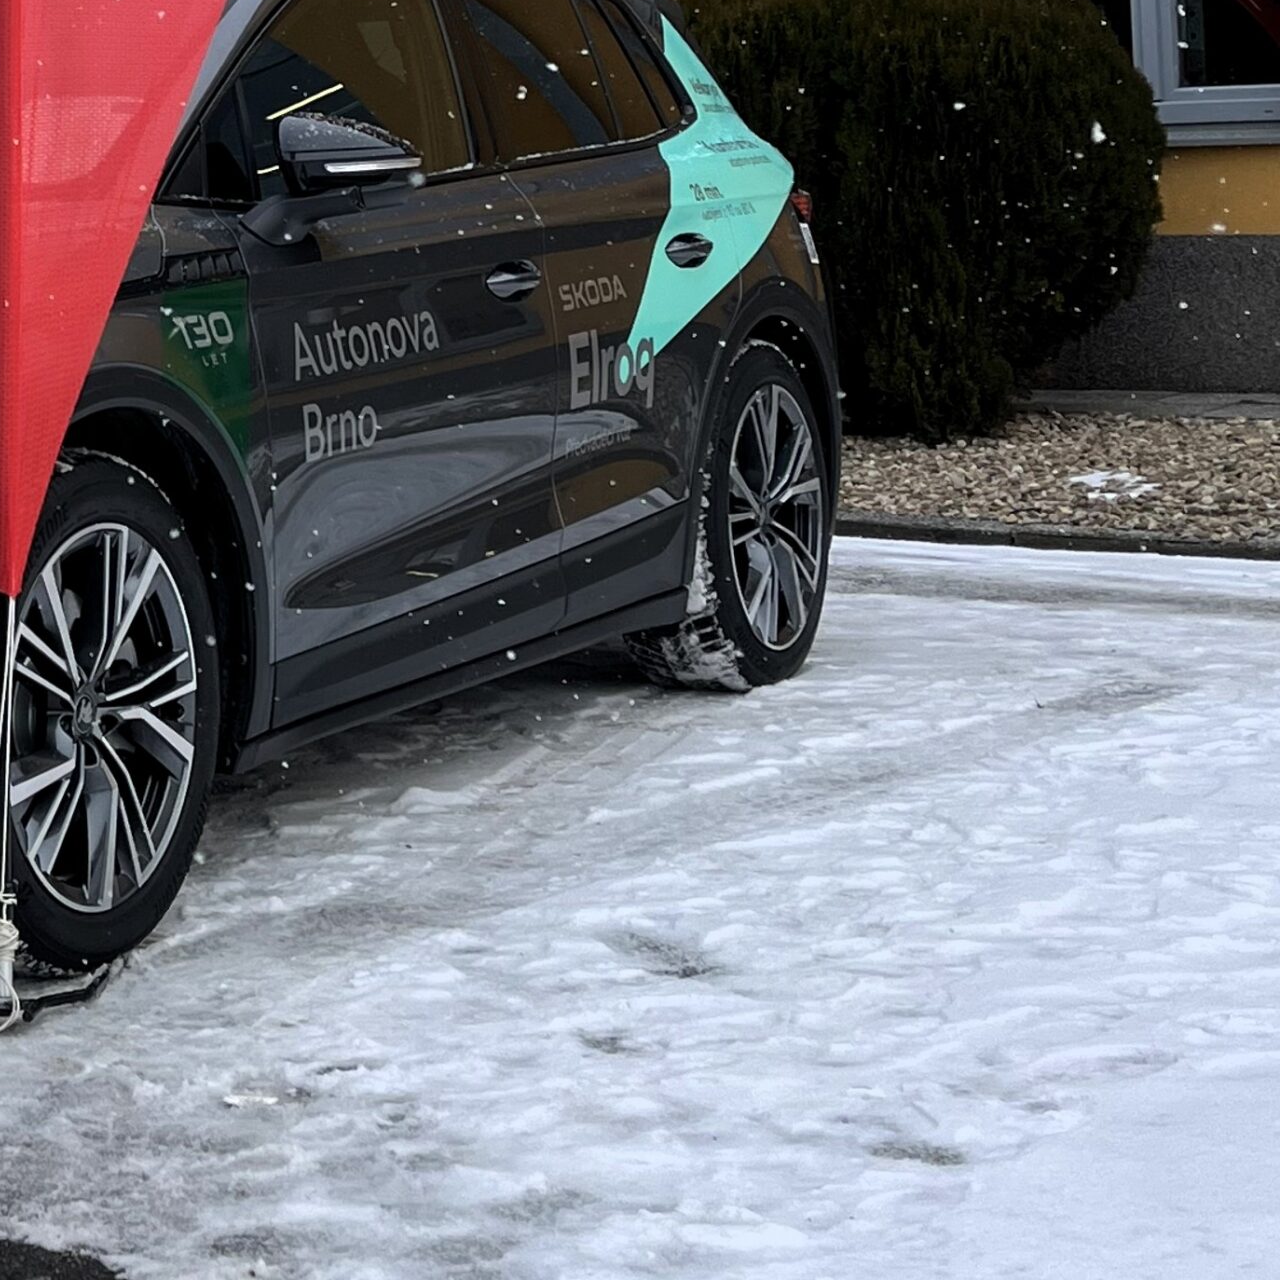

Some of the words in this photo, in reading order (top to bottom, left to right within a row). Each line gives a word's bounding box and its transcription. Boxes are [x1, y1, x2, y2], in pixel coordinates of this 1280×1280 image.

[201, 352, 228, 367] LET
[294, 311, 439, 381] Autonova
[568, 329, 655, 410] Elroq
[302, 403, 378, 462] Brno
